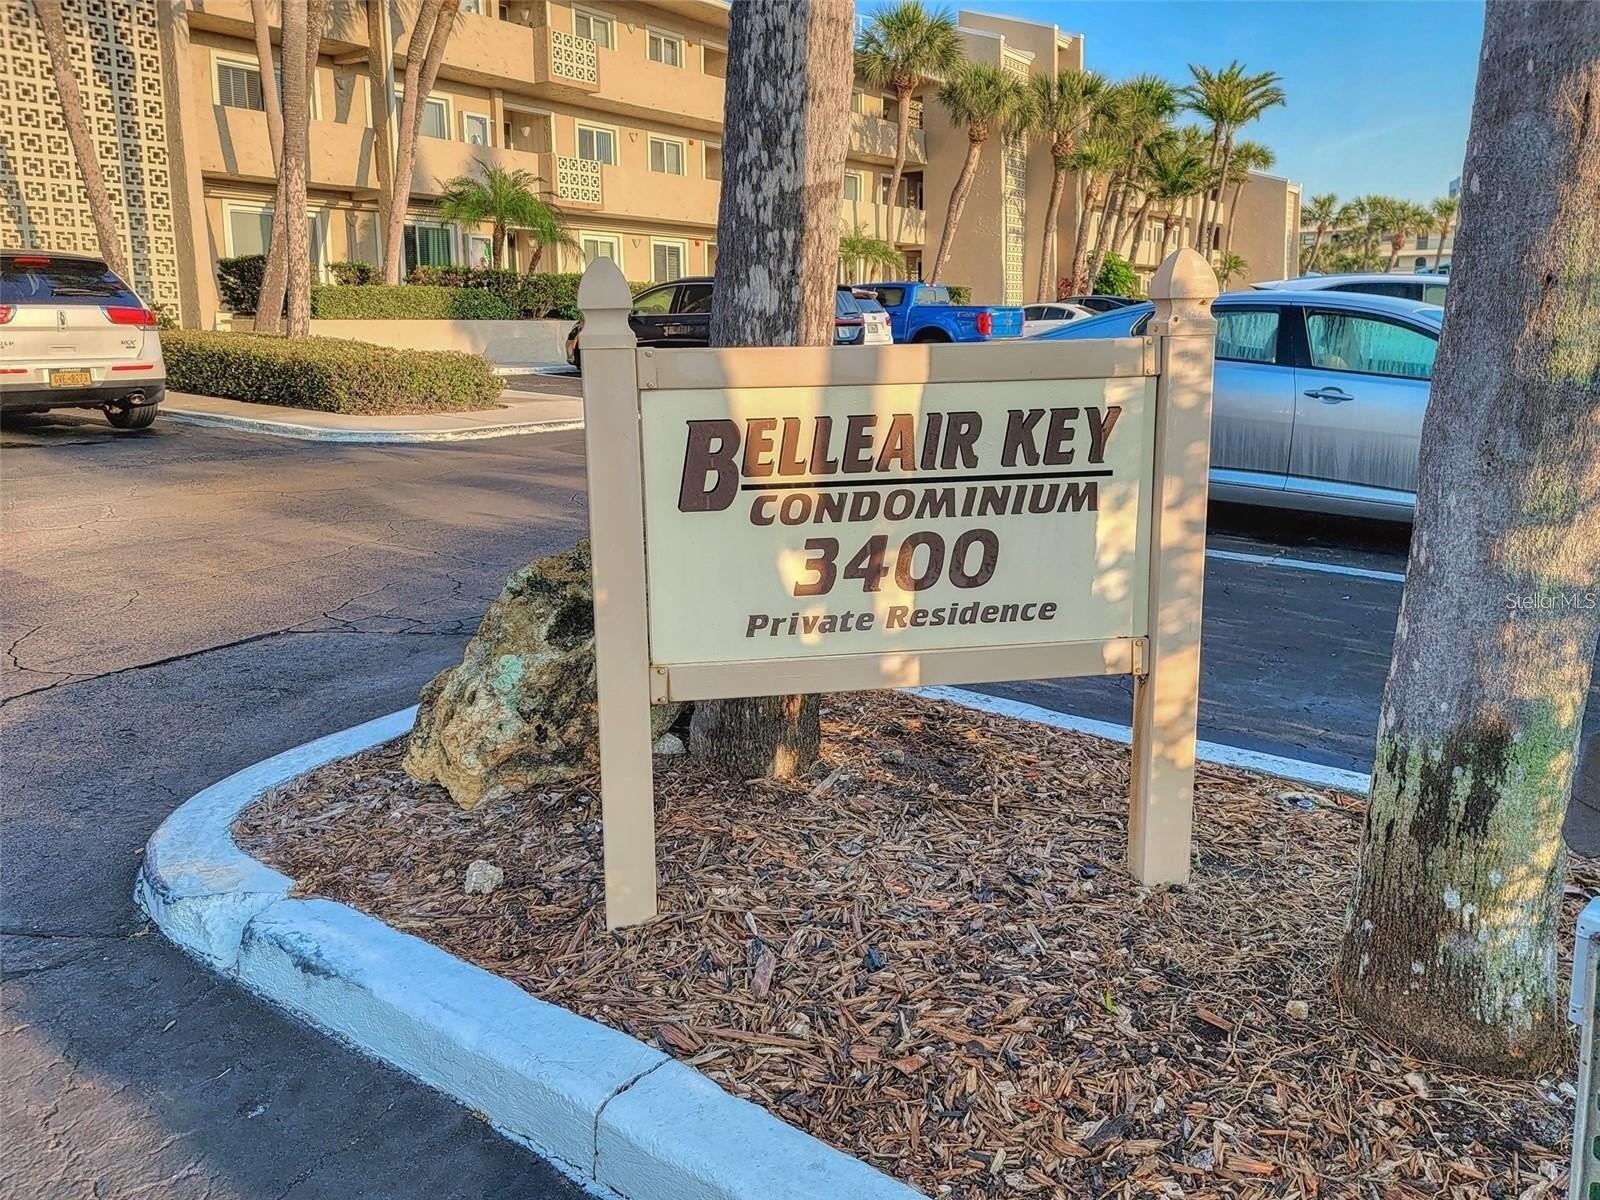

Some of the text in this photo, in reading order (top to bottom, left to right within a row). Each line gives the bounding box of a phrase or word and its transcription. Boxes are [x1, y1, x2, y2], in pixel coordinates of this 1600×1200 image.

[677, 406, 1122, 513] BELLEAIR KEY
[750, 481, 1099, 526] CONDOMINIUM
[793, 528, 999, 597] 3400
[745, 600, 1057, 638] Private Residence
